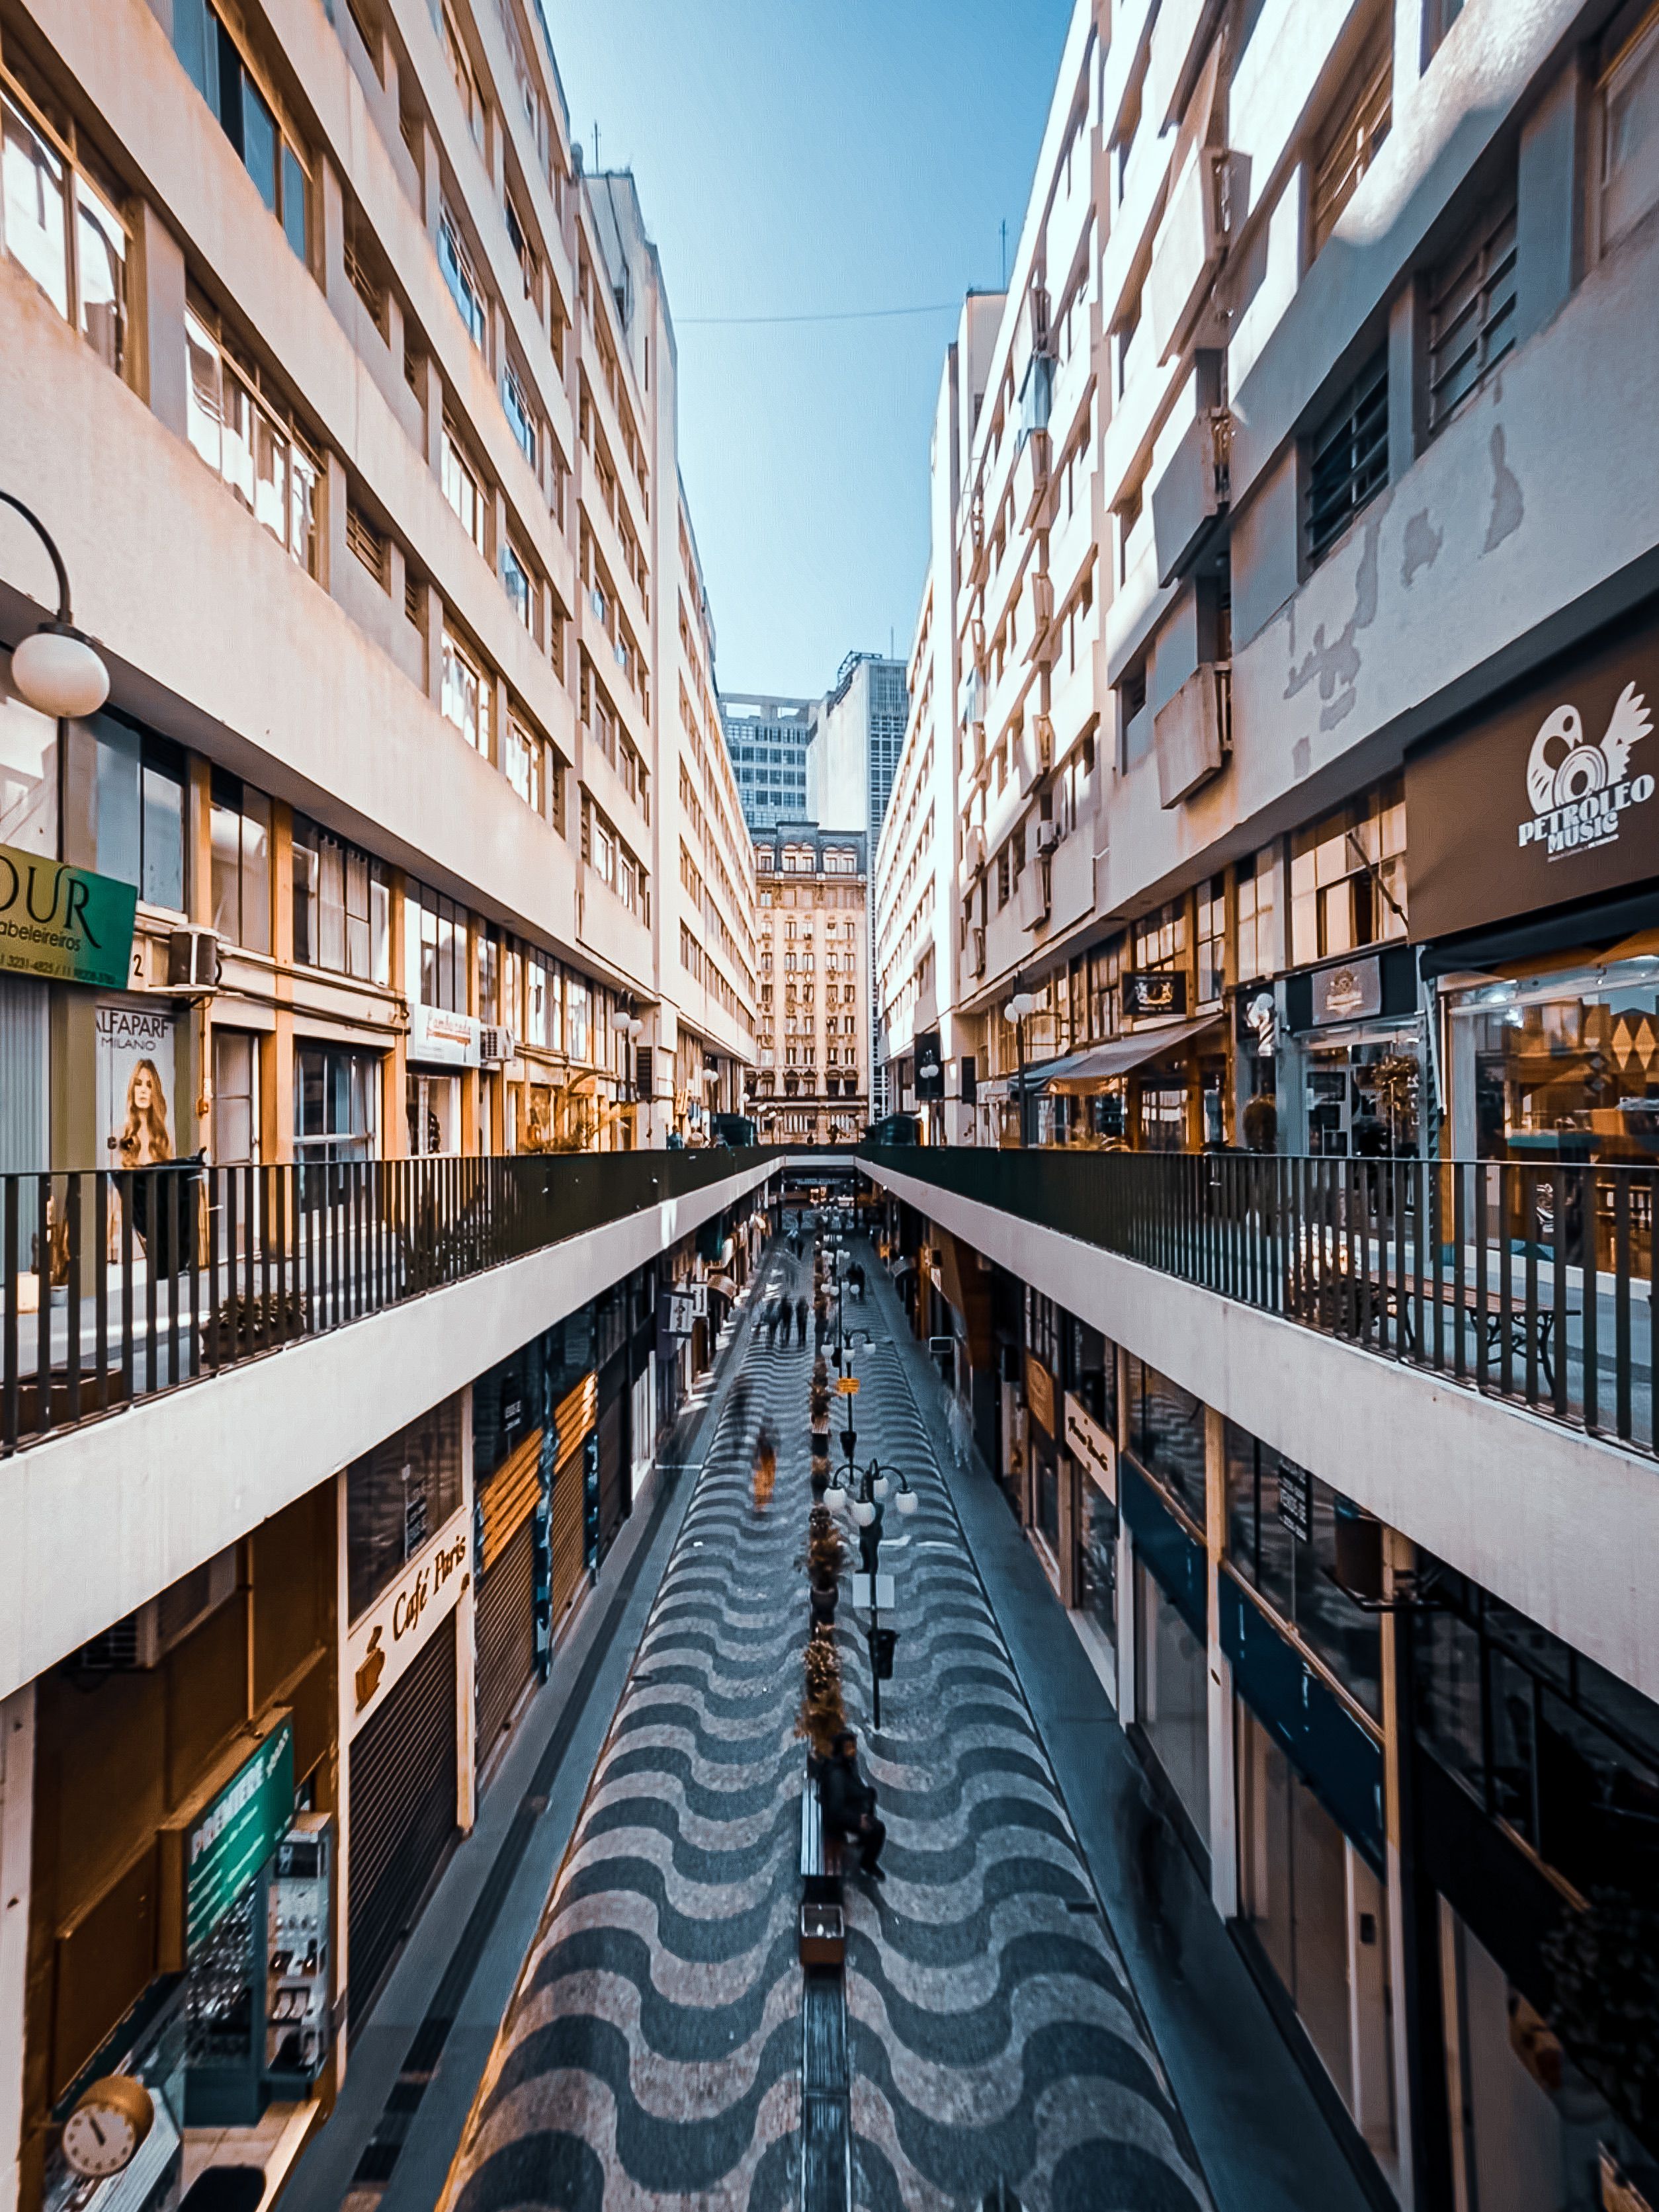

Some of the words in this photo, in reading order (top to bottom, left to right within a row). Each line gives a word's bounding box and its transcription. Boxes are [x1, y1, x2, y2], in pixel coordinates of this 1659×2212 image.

[1547, 809, 1619, 854] MUSIC
[134, 954, 144, 977] 2
[101, 1036, 156, 1051] MILANO
[393, 1567, 430, 1641] Café
[433, 1535, 466, 1596] Paris
